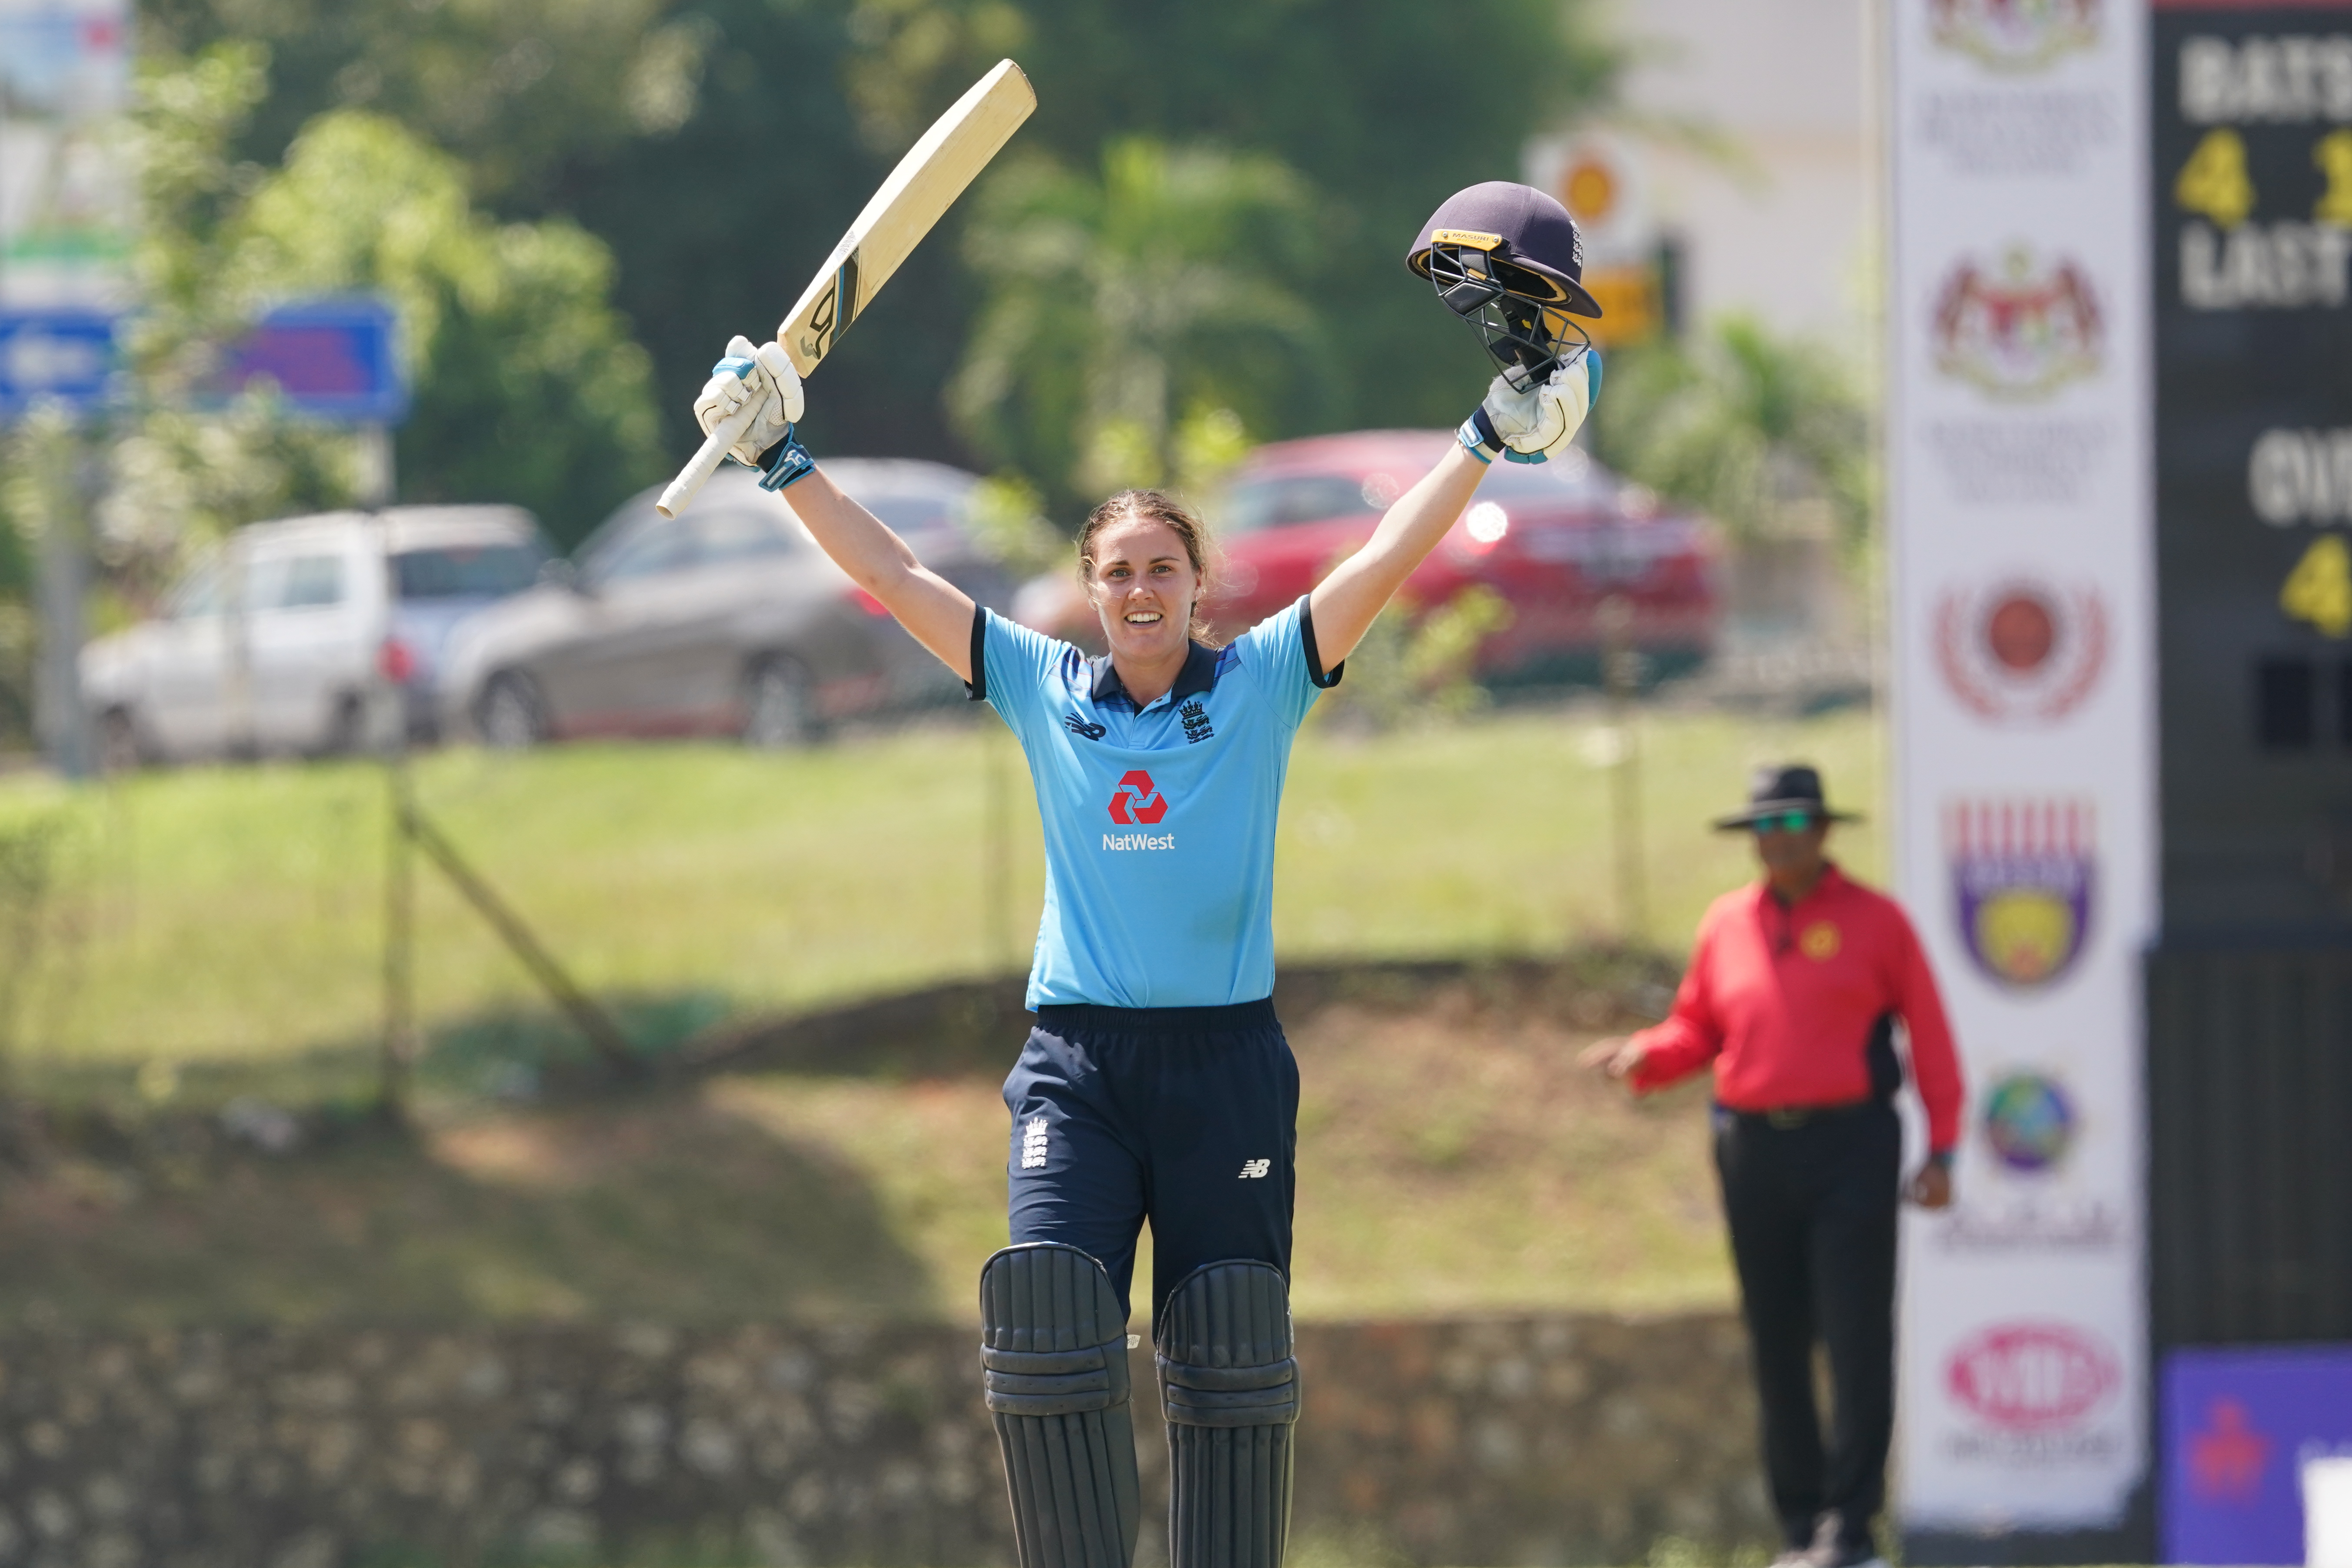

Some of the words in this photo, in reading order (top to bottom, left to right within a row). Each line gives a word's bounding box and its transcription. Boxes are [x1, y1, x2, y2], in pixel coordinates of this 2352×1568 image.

[2175, 128, 2257, 229] 4
[2178, 219, 2347, 309] LAST
[2280, 535, 2352, 638] 4
[1103, 833, 1175, 851] NatWest
[1238, 1159, 1270, 1178] NB
